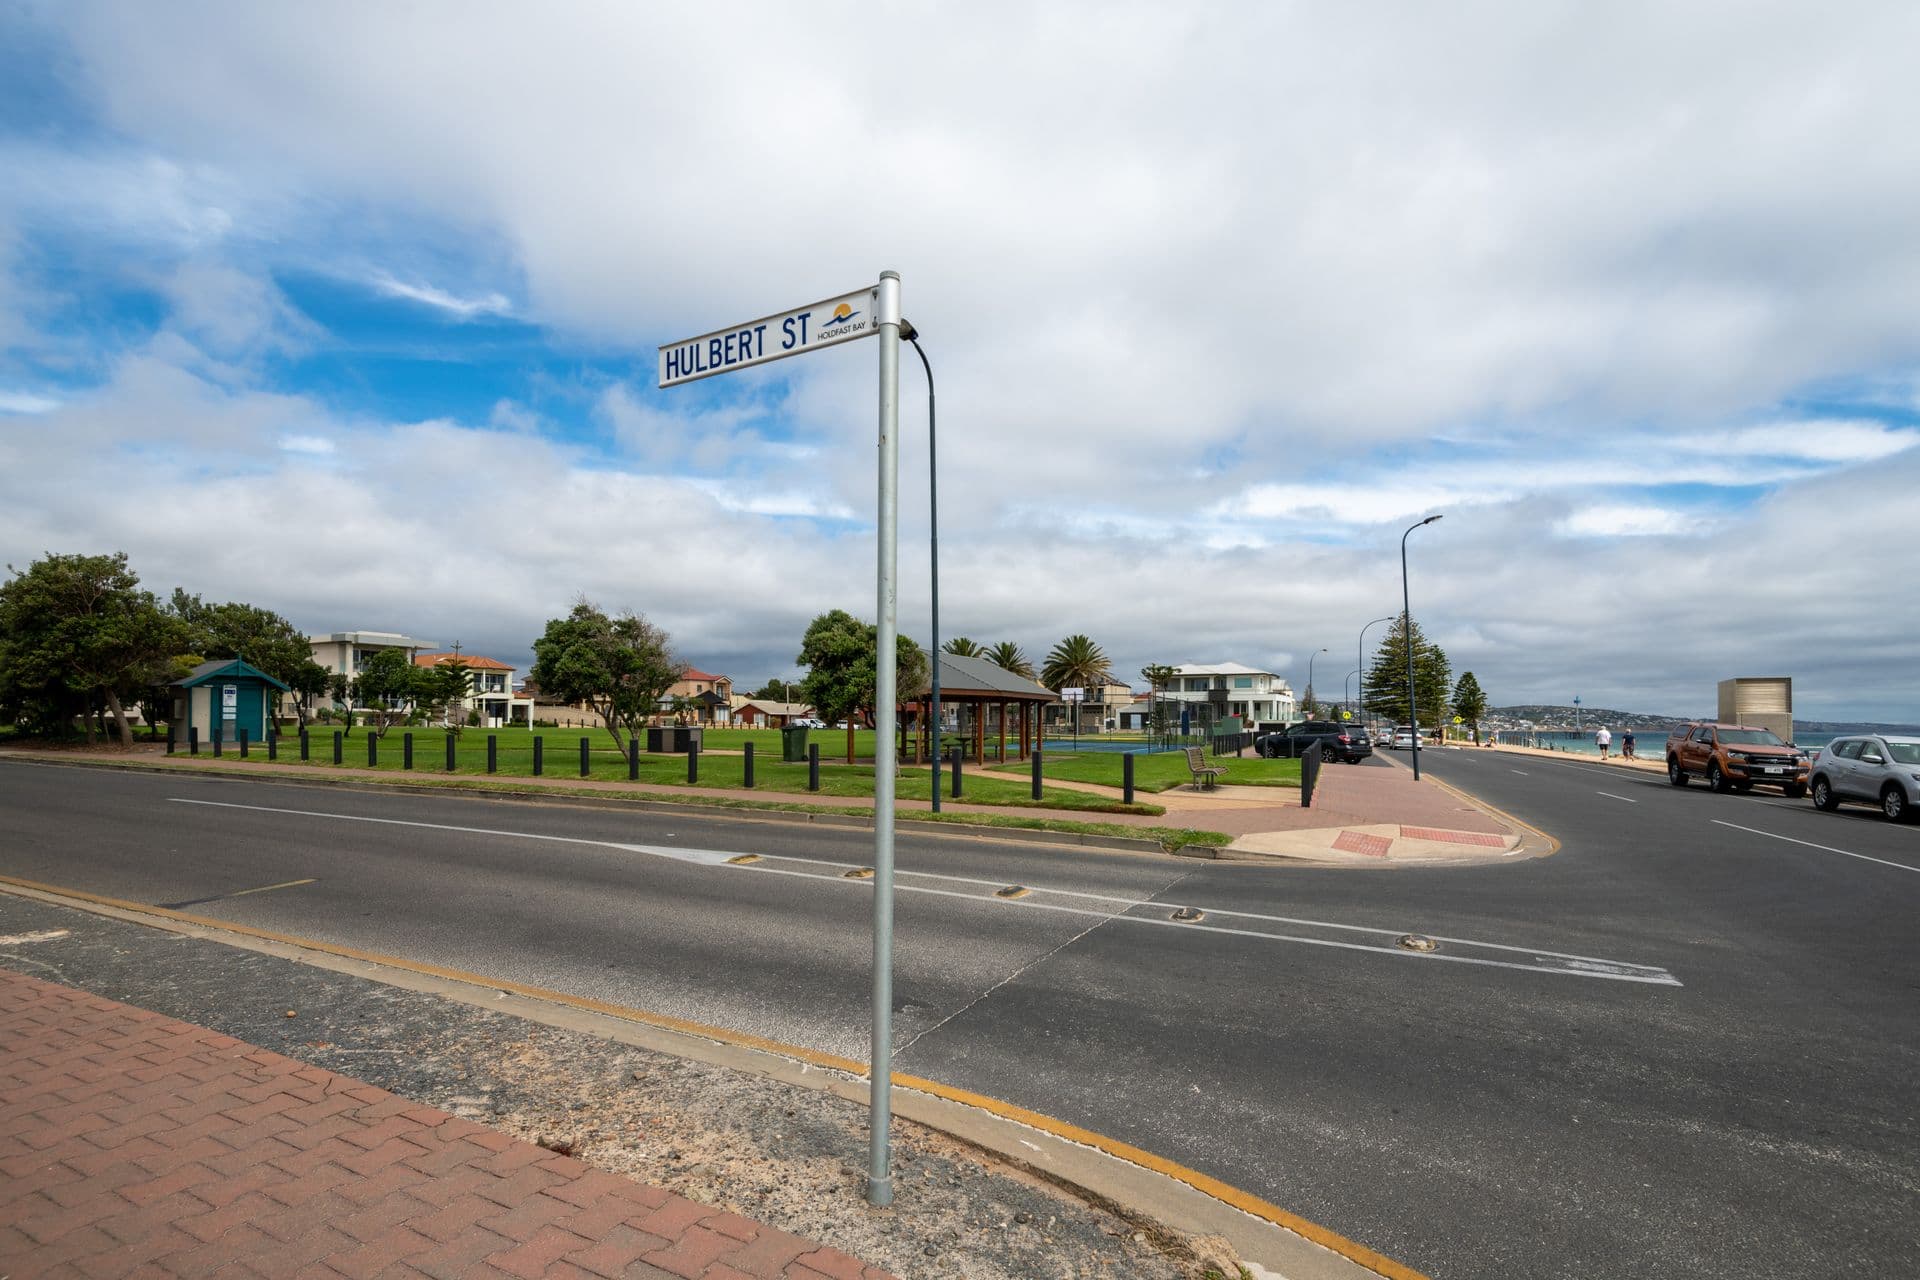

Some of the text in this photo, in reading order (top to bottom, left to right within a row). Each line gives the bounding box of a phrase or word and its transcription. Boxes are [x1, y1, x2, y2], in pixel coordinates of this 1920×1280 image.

[666, 312, 811, 380] HULBERT ST
[818, 321, 866, 341] HOLDFAST BAY
